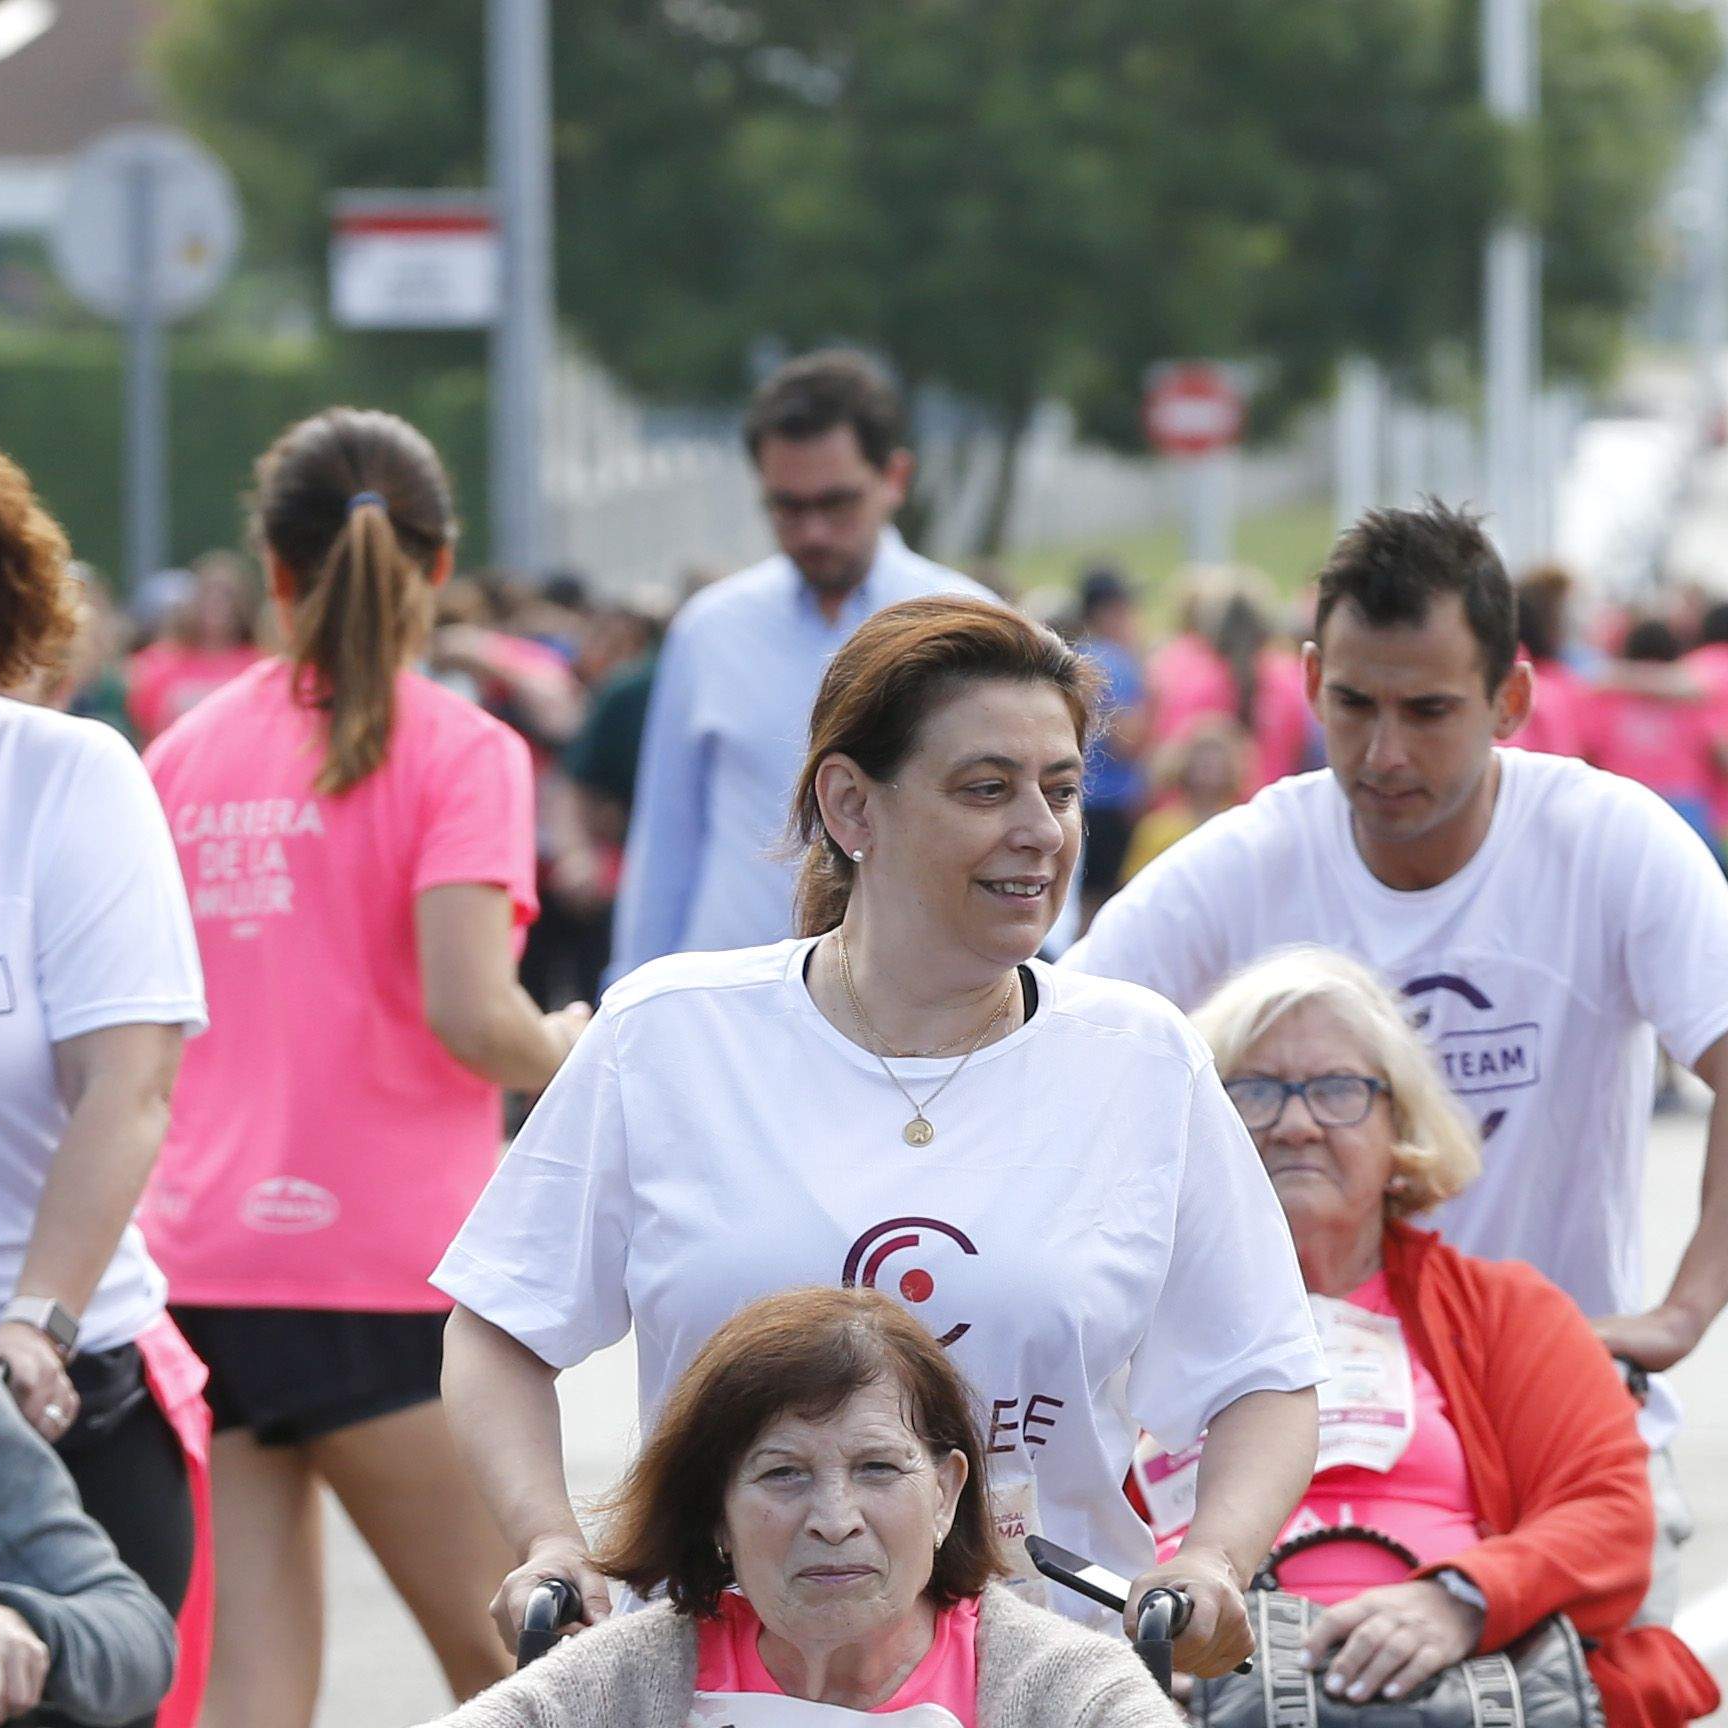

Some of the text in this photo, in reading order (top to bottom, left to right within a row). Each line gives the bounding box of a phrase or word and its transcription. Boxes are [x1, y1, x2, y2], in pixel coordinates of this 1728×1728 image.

[175, 798, 325, 844] CARRERA
[198, 839, 239, 880] DE
[194, 873, 295, 918] MUJER
[1442, 1044, 1527, 1078] TEAM
